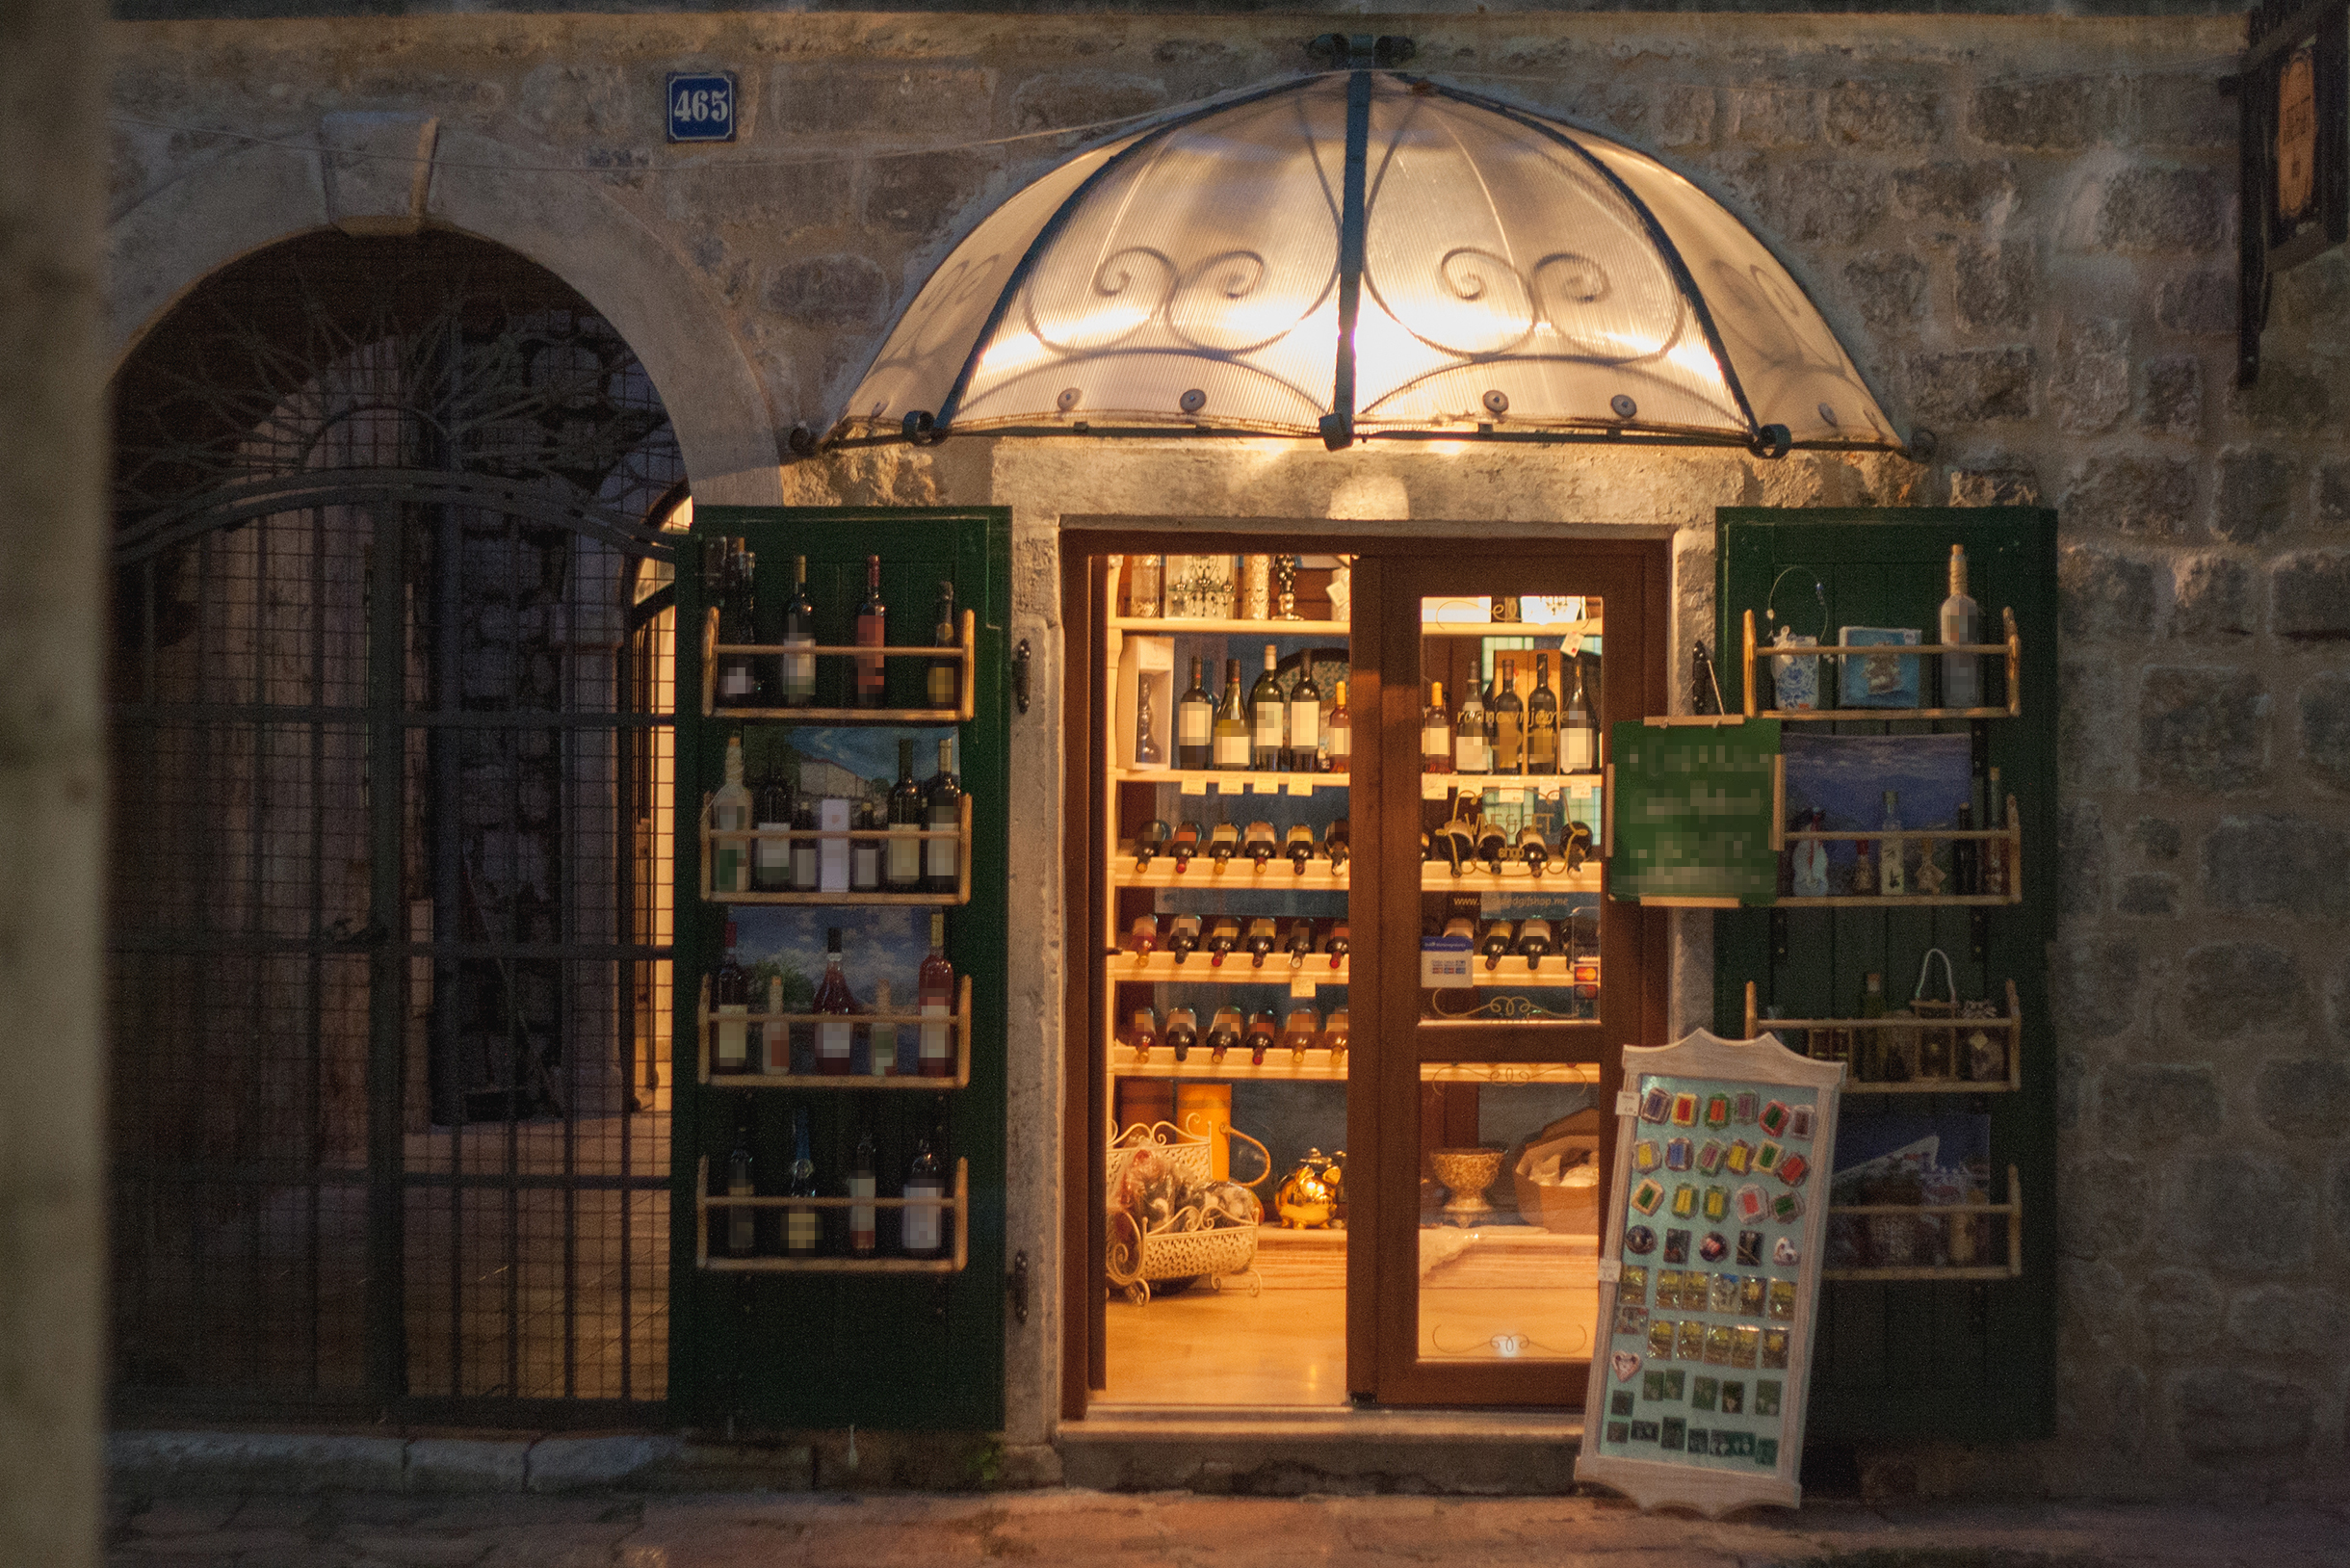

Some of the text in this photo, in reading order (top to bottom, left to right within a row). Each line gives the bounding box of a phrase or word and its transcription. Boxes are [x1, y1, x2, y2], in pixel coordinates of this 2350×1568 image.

[674, 90, 729, 122] 465
[1509, 707, 1568, 728] vrjeme
[1505, 813, 1518, 835] &
[1522, 813, 1554, 835] GIFT
[1498, 844, 1525, 867] shop
